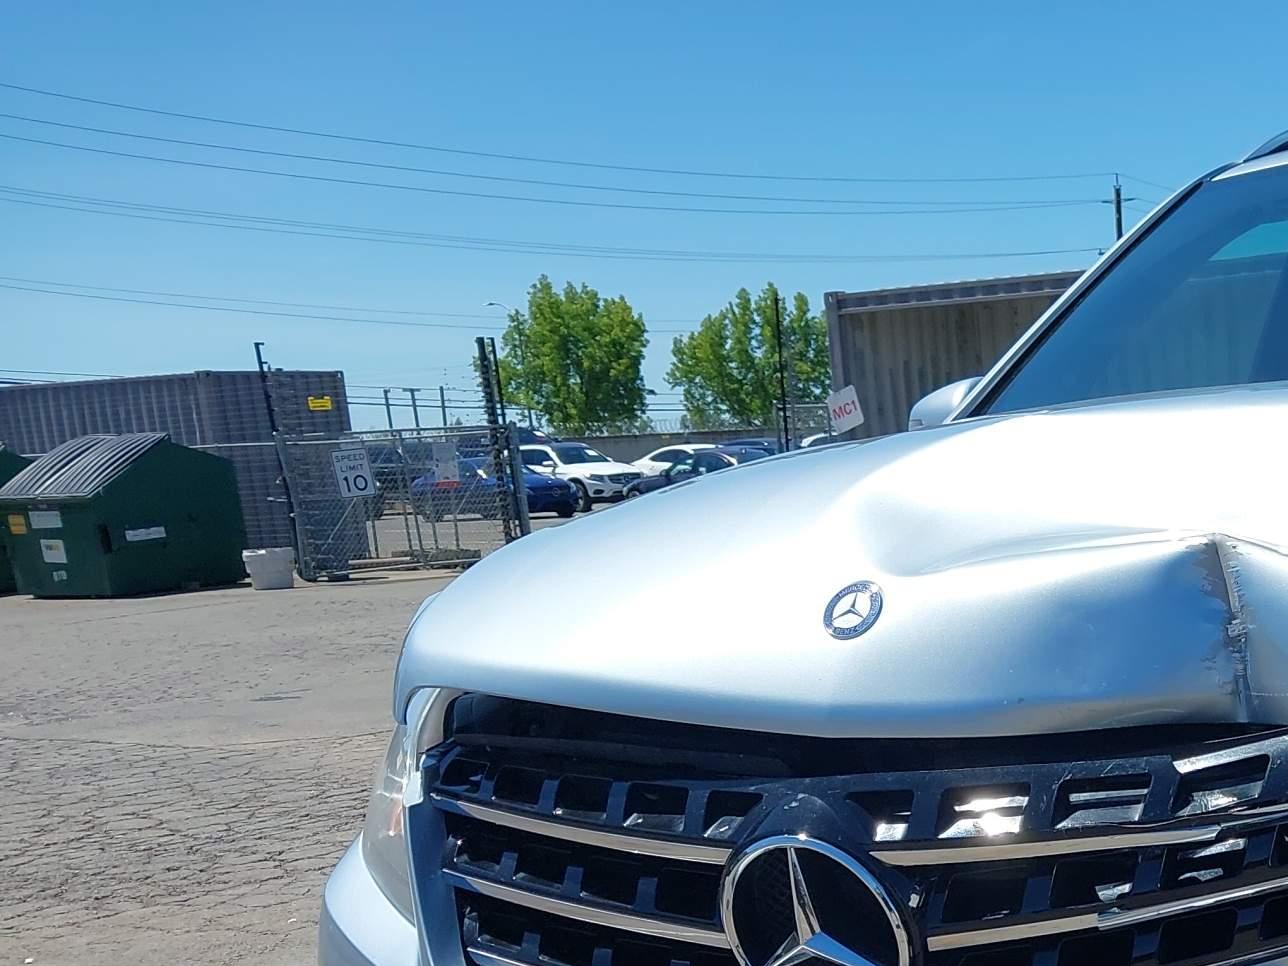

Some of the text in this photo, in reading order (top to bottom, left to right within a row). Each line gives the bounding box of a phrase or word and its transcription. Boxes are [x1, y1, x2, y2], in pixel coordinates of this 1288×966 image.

[832, 400, 858, 420] MC1
[335, 453, 365, 463] SPEED
[340, 463, 364, 472] LIMIT
[343, 474, 369, 493] 10
